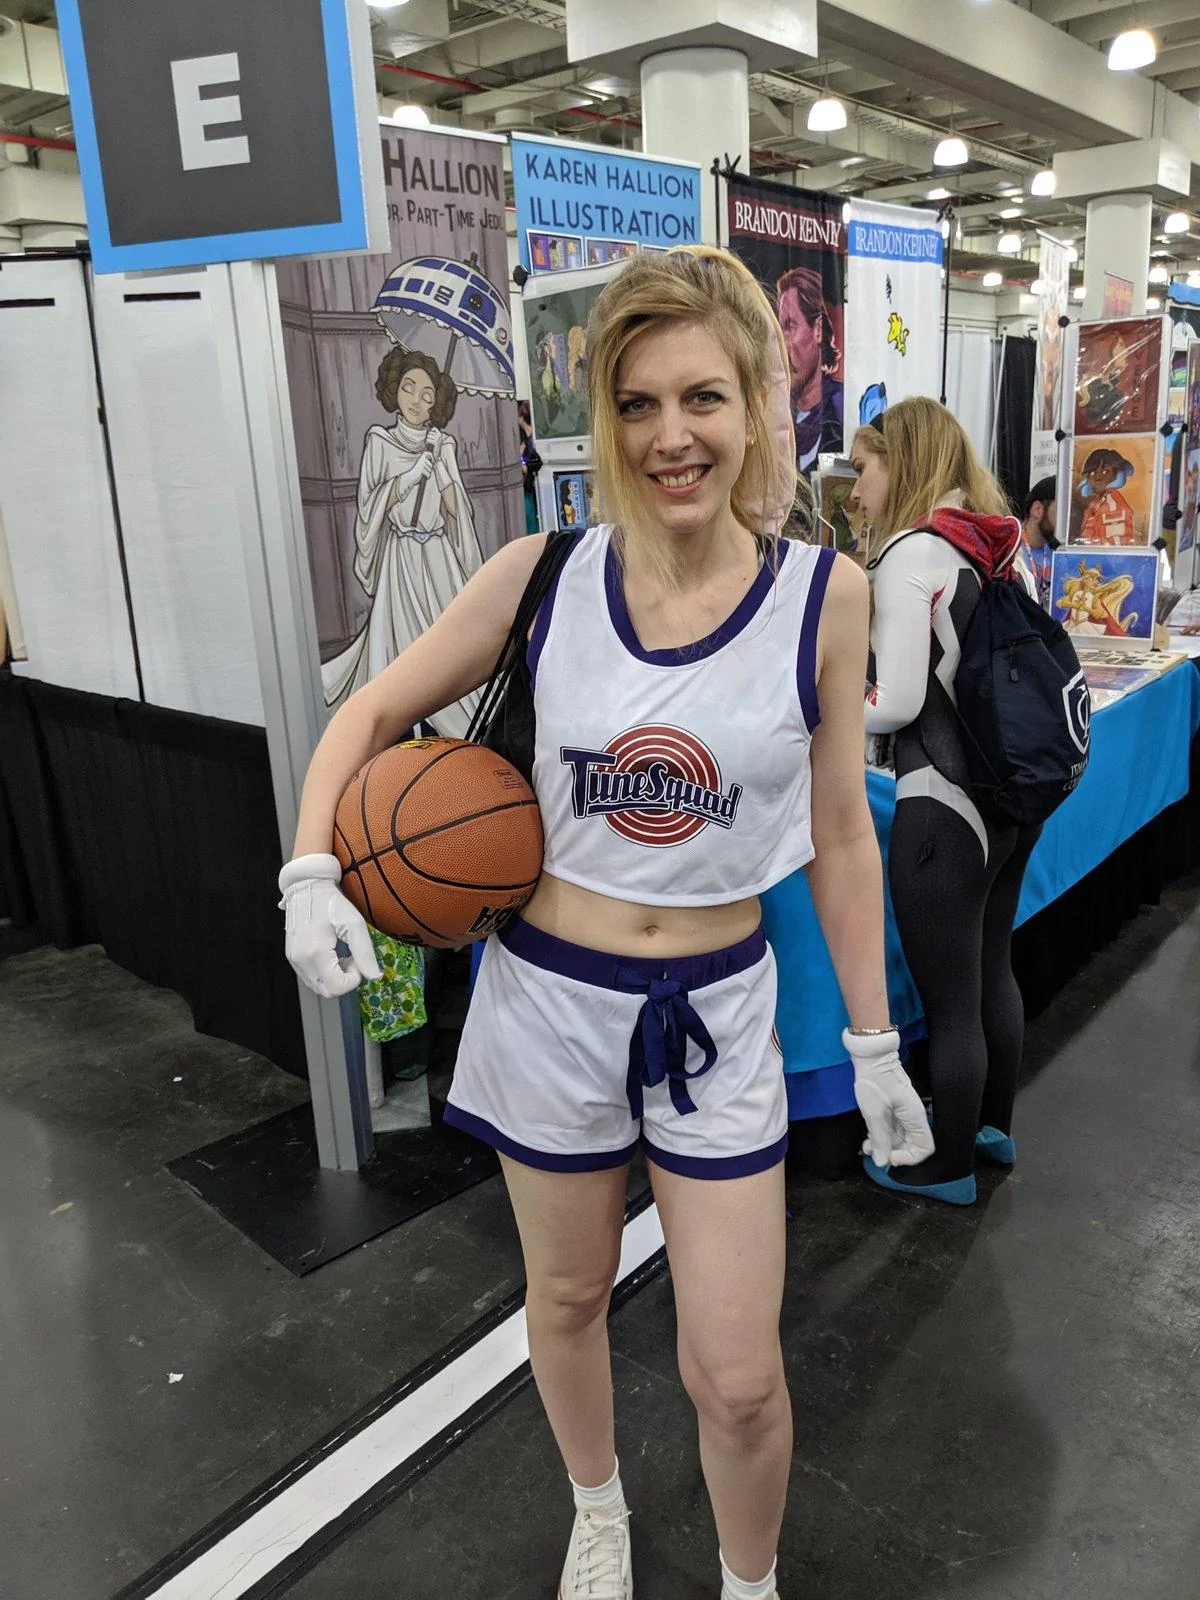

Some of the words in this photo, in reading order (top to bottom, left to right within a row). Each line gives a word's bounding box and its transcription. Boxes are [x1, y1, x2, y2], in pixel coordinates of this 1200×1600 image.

[170, 52, 251, 171] E
[381, 138, 500, 202] HALLION
[526, 153, 597, 187] KAREN
[606, 165, 694, 200] HALLION
[406, 199, 476, 233] PART-TIME
[530, 196, 696, 241] ILLUSTRATION
[734, 201, 797, 240] BRANDON
